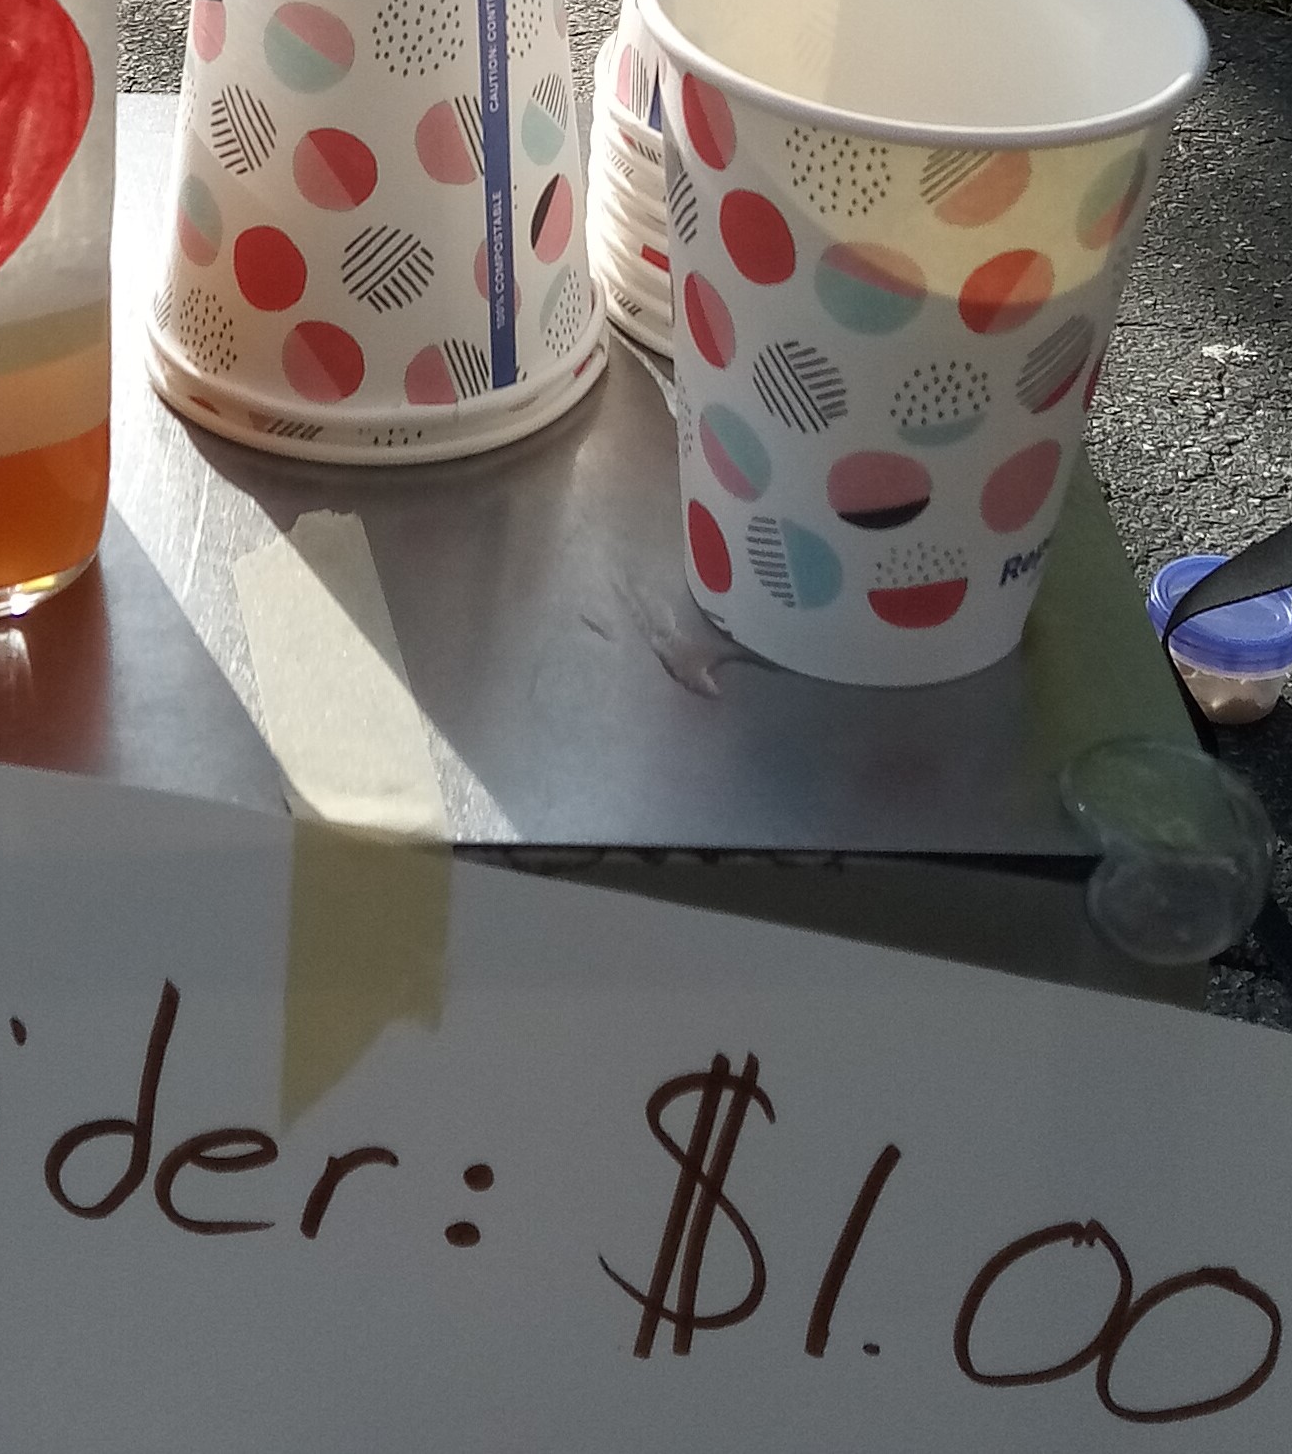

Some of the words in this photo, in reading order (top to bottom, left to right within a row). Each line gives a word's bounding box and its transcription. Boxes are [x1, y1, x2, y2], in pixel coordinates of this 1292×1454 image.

[488, 44, 500, 114] CAUTION:
[492, 189, 505, 294] COMPOSTABLE
[597, 1051, 1283, 1424] $1.00
